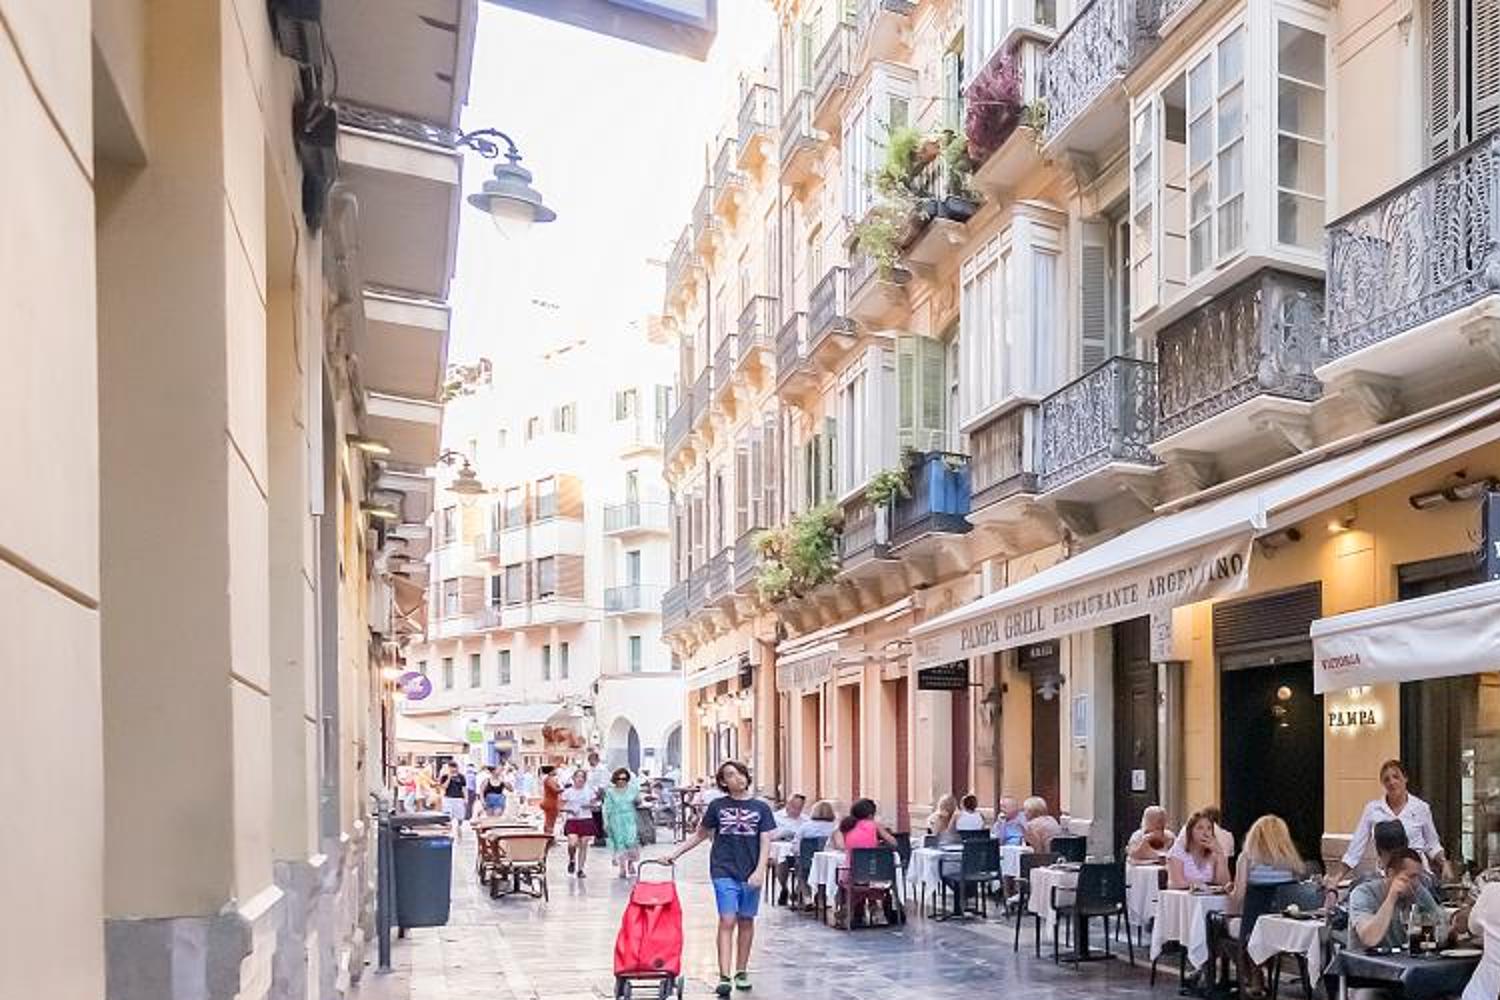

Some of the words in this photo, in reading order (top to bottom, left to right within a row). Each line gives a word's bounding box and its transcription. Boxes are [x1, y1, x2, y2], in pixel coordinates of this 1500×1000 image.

[959, 619, 1000, 651] PAMPA
[1004, 606, 1046, 640] GRILL
[1053, 585, 1139, 625] RESTAURANTE
[1328, 709, 1377, 727] PAMPA
